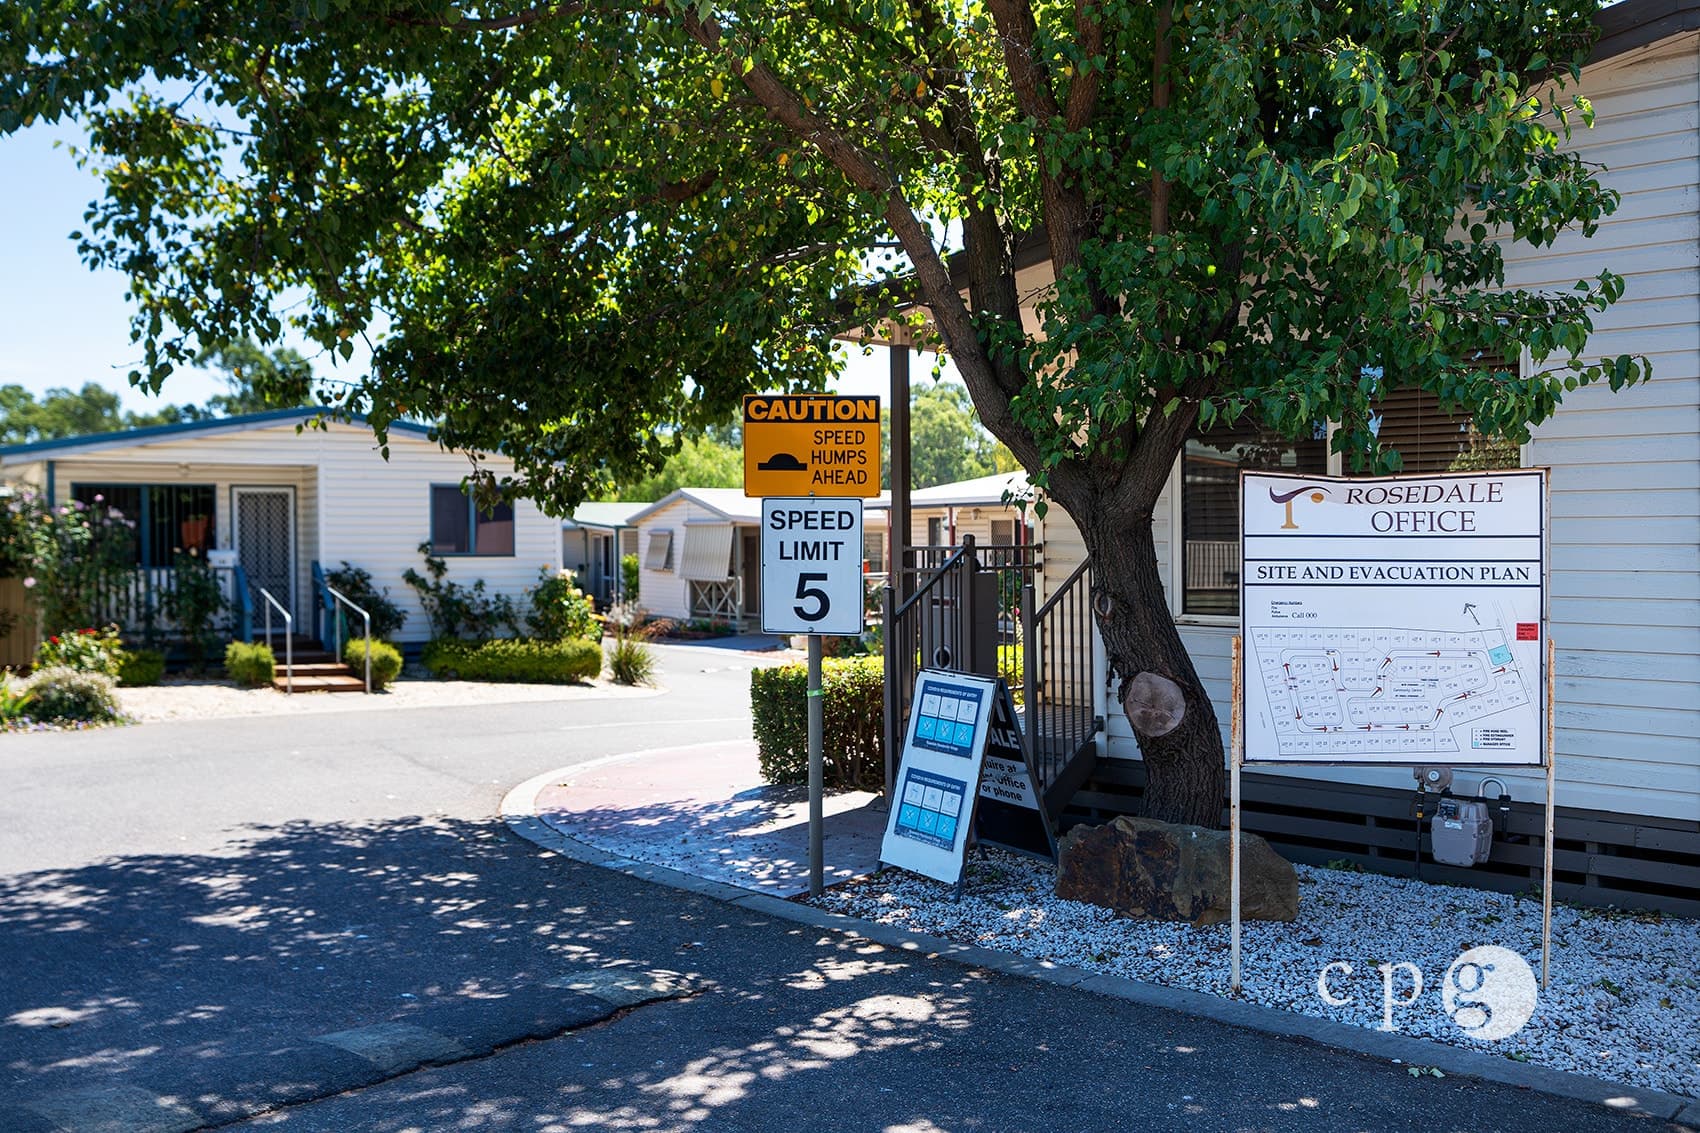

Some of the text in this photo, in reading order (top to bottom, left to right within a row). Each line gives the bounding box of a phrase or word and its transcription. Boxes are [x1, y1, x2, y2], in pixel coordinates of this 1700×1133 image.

[748, 400, 876, 420] CAUTION
[813, 430, 865, 445] SPEED
[811, 450, 867, 464] HUMPS
[812, 470, 867, 484] AHEAD
[1344, 482, 1504, 504] ROSEDALE
[770, 510, 855, 530] SPEED
[1371, 510, 1476, 533] OFFICE
[780, 541, 844, 560] LIMIT
[1257, 566, 1530, 580] SITE AND EVACUATION PLAN
[793, 572, 830, 621] 5
[989, 728, 1020, 750] ALE
[985, 760, 1016, 773] uire at
[982, 784, 1022, 801] or phone
